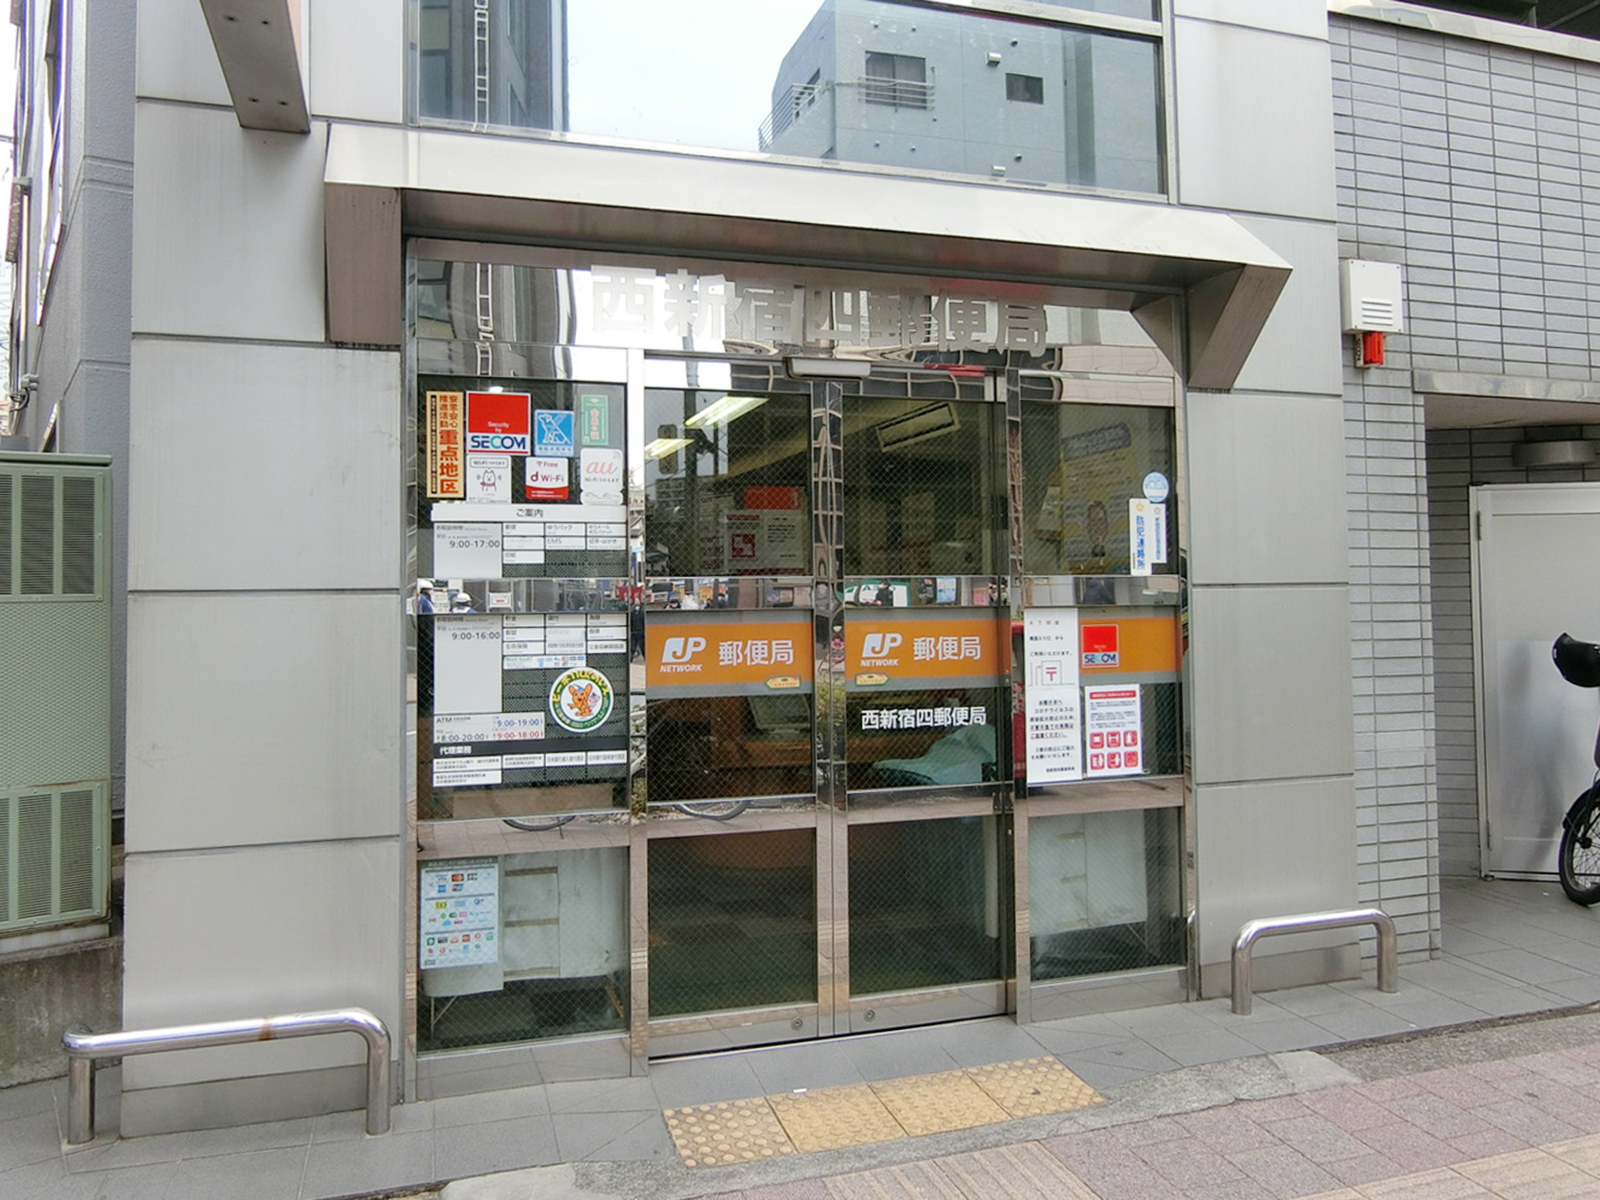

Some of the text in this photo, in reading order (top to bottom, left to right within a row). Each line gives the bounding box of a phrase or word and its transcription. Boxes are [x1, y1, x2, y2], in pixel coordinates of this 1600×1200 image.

[591, 265, 1048, 357] 西新宿四郵便局
[487, 421, 510, 429] Security
[471, 435, 526, 450] SECOM
[439, 430, 458, 494] 重点地区
[586, 461, 618, 475] au
[540, 474, 565, 483] Wi-Fi
[516, 508, 544, 518] ご案内
[449, 540, 500, 548] 9:00-17:00
[452, 632, 501, 640] 9:00-16:00
[718, 639, 794, 666] 郵便局
[912, 636, 981, 661] 郵便局
[860, 658, 898, 667] NETWORK
[1084, 653, 1117, 664] SECOM
[659, 663, 702, 673] NETWORK
[496, 718, 540, 727] 9:00-19:00
[860, 706, 987, 730] 西新宿四郵便局
[441, 733, 485, 742] 8:00-20:00
[496, 731, 540, 740] 9:00-18:00
[439, 745, 472, 755] 代理業務
